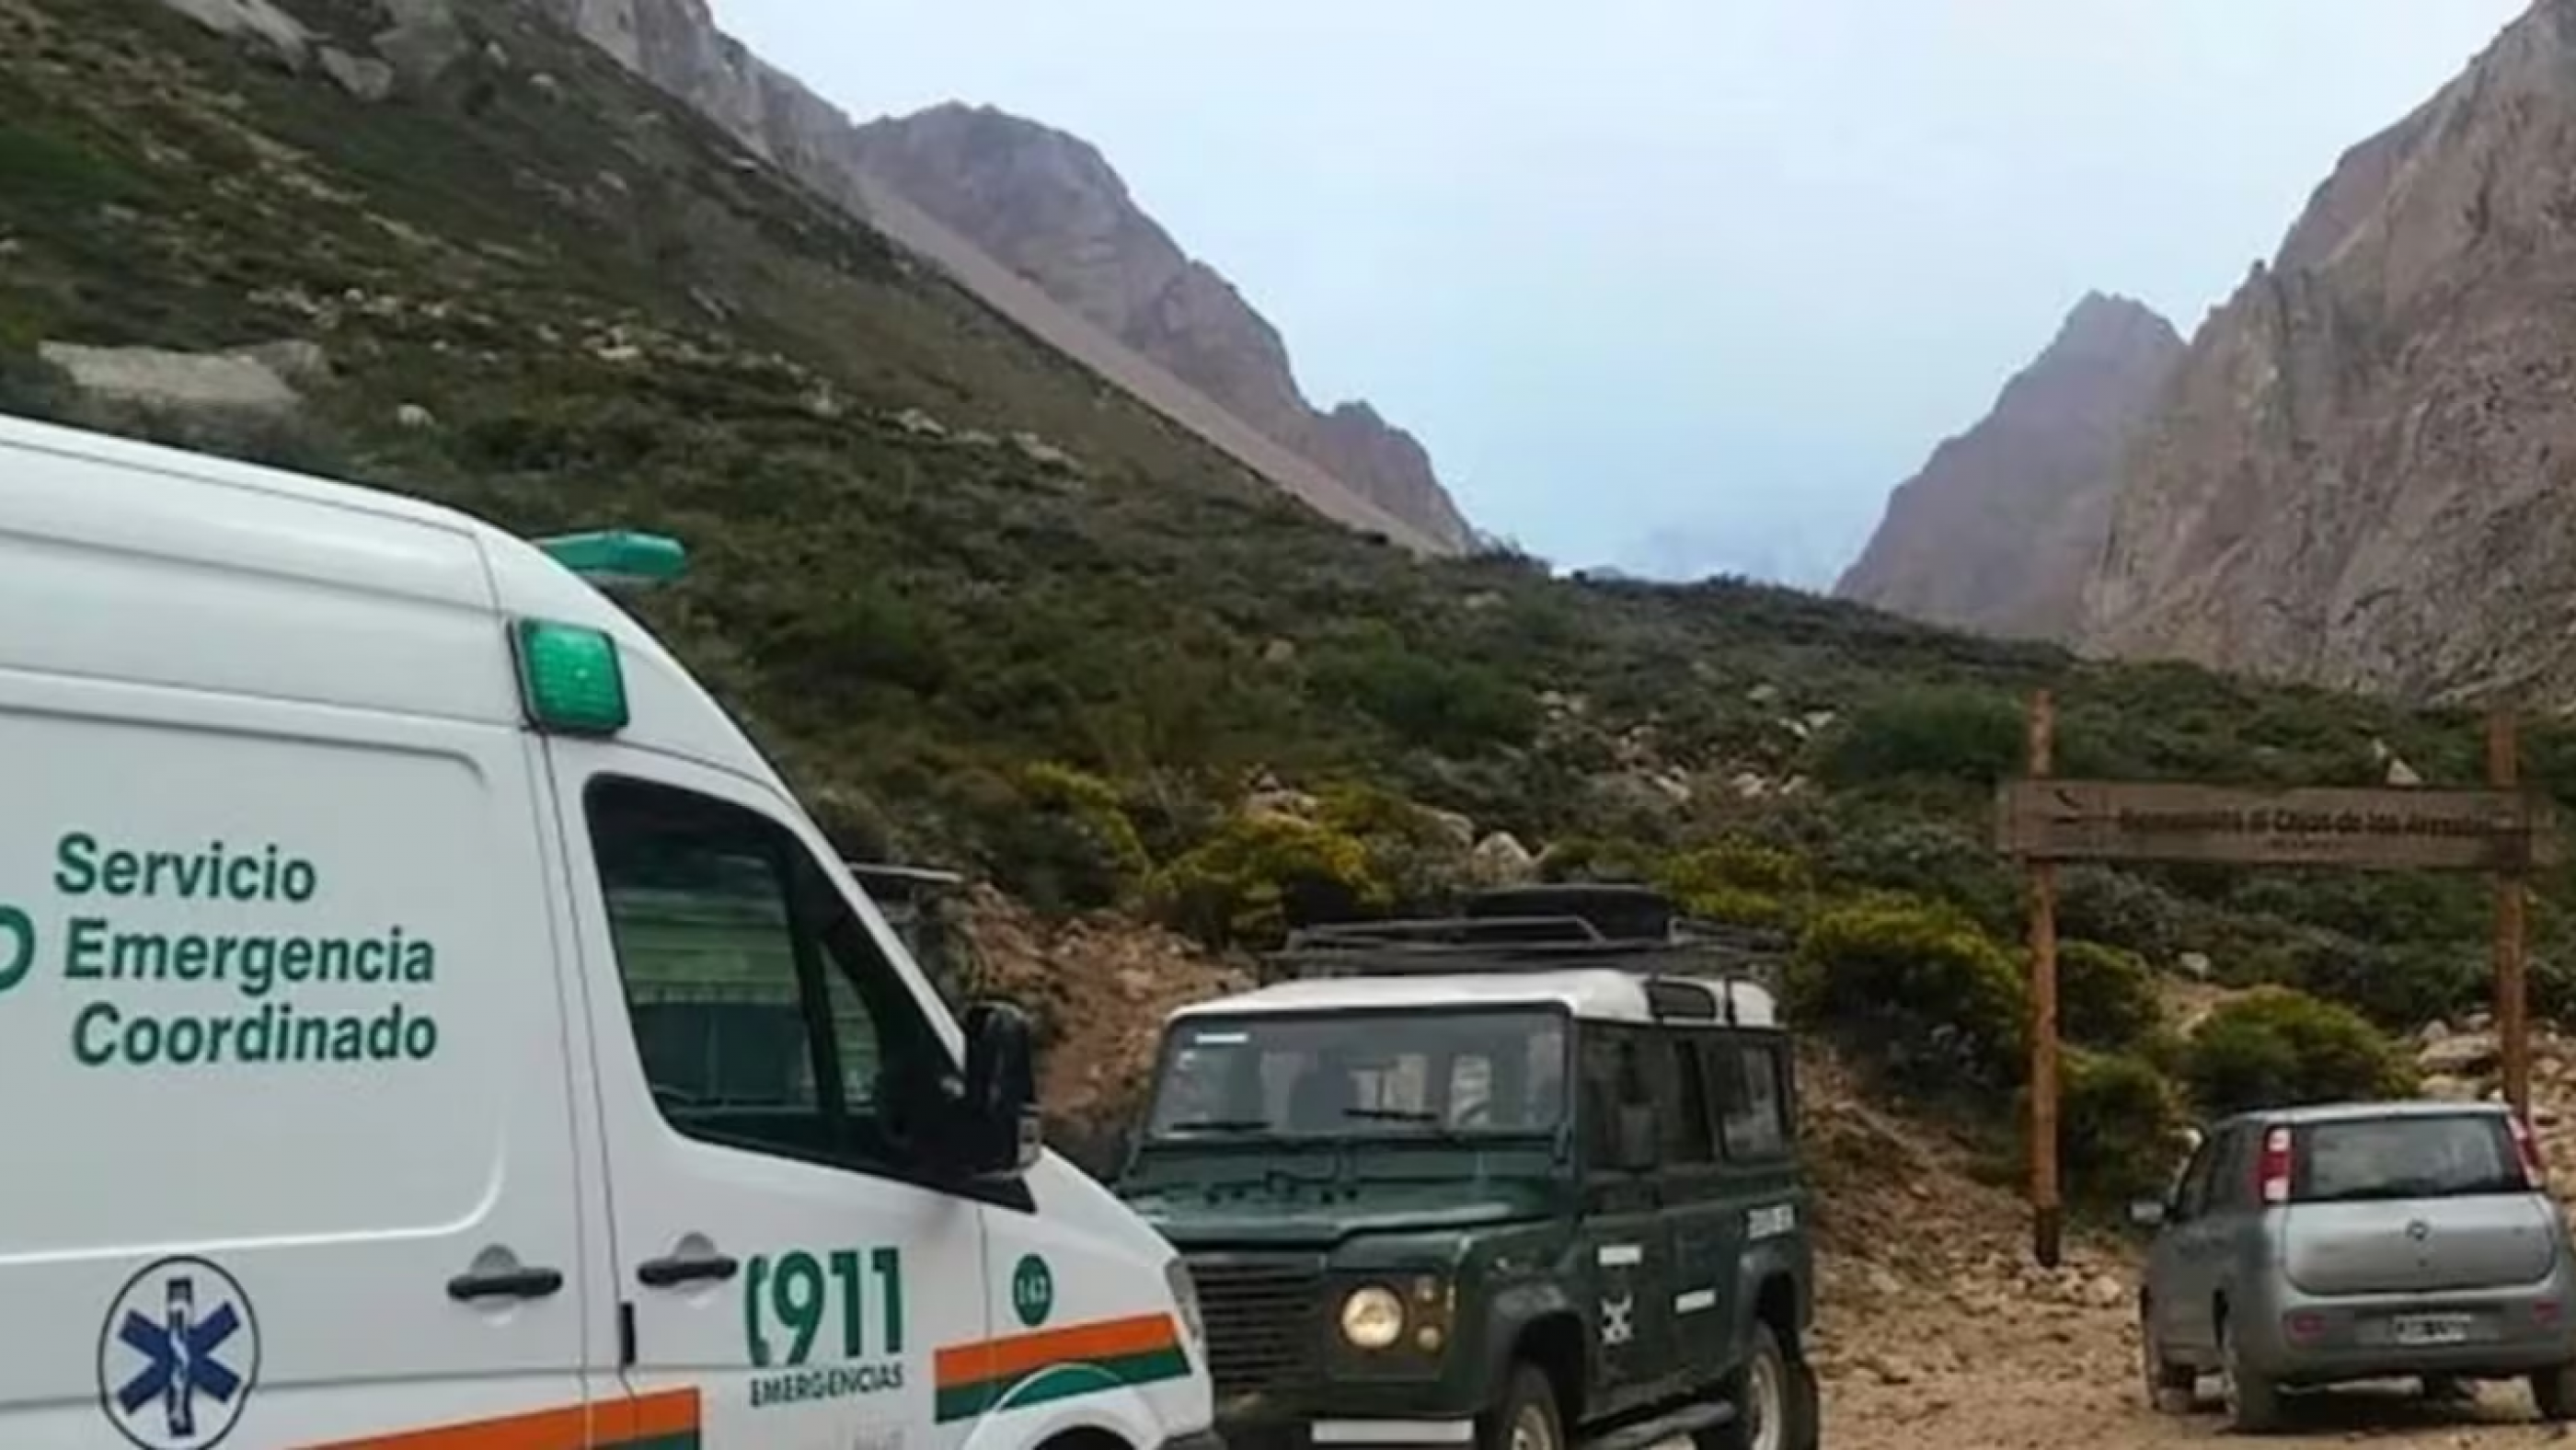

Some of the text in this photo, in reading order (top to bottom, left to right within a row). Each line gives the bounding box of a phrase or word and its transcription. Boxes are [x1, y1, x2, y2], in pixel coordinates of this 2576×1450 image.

[54, 833, 316, 902] Servicio
[63, 917, 433, 997] Emergencia
[72, 1002, 437, 1065] Coordinado
[773, 1247, 903, 1365] 911
[750, 1364, 903, 1408] EMERGENCIAS
